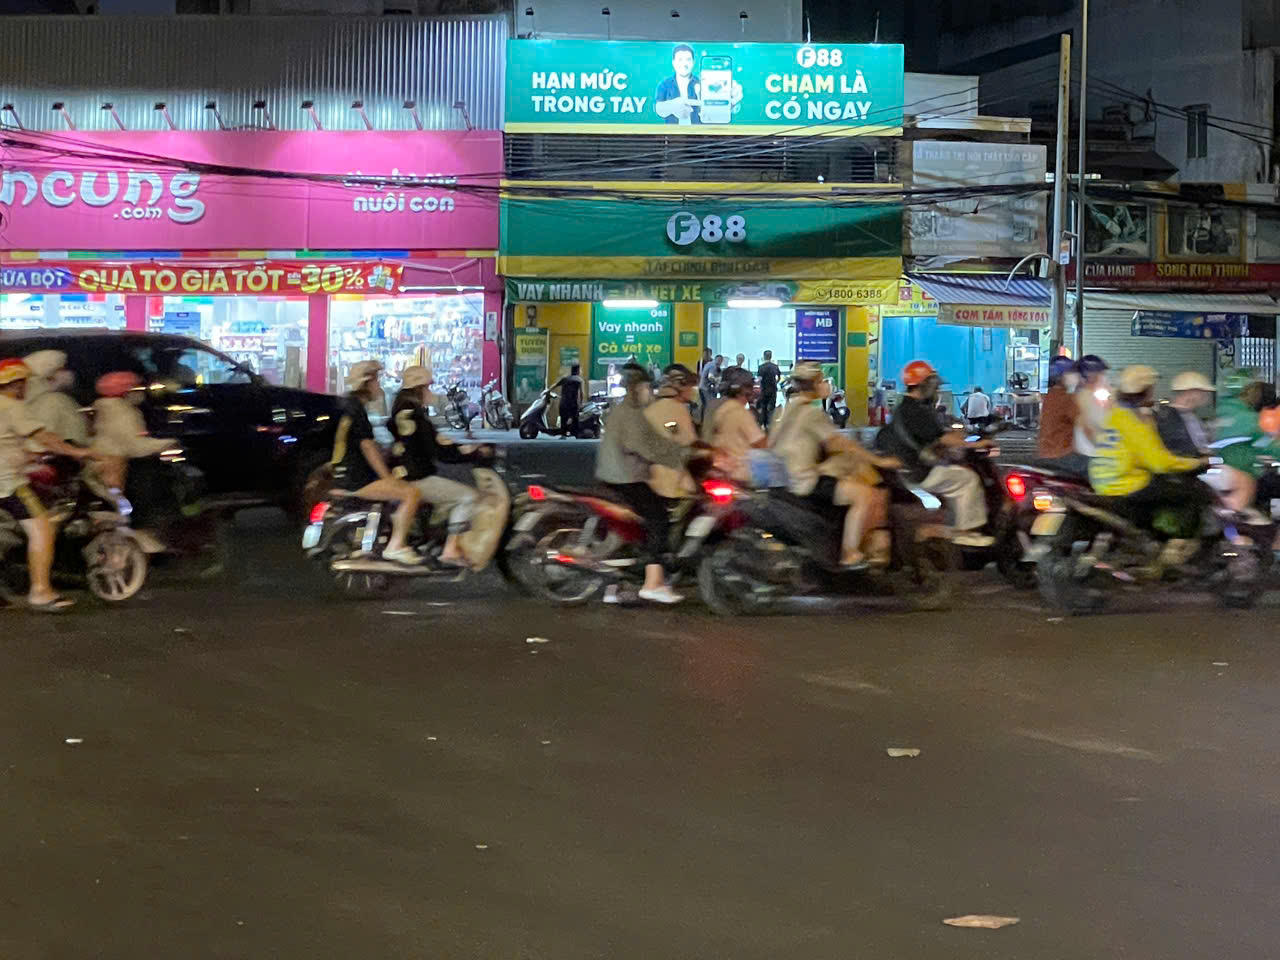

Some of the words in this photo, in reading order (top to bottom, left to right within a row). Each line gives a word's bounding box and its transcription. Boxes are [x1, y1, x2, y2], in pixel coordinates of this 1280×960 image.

[796, 47, 843, 69] F88
[531, 71, 575, 92] HẠN
[580, 69, 628, 91] MỨC
[764, 74, 836, 96] CHẠM
[840, 68, 869, 95] LÀ
[531, 95, 605, 114] TRONG
[609, 95, 647, 114] TAY
[764, 95, 802, 121] CÓ
[807, 100, 872, 120] NGAY
[353, 193, 405, 212] nuôi
[409, 196, 455, 212] con
[666, 211, 747, 246] F88
[31, 268, 65, 289] BỘT
[79, 264, 138, 291] QUÀ
[140, 269, 177, 291] TO
[231, 265, 285, 291] TỐT
[517, 283, 545, 300] VAY
[549, 283, 604, 300] NHANH
[682, 284, 702, 300] XE
[828, 289, 853, 299] 1800
[856, 289, 882, 299] 6388
[598, 321, 621, 334] Vay
[624, 321, 663, 332] nhanh
[815, 318, 833, 327] MB
[598, 341, 618, 353] Cà
[646, 344, 662, 353] xe
